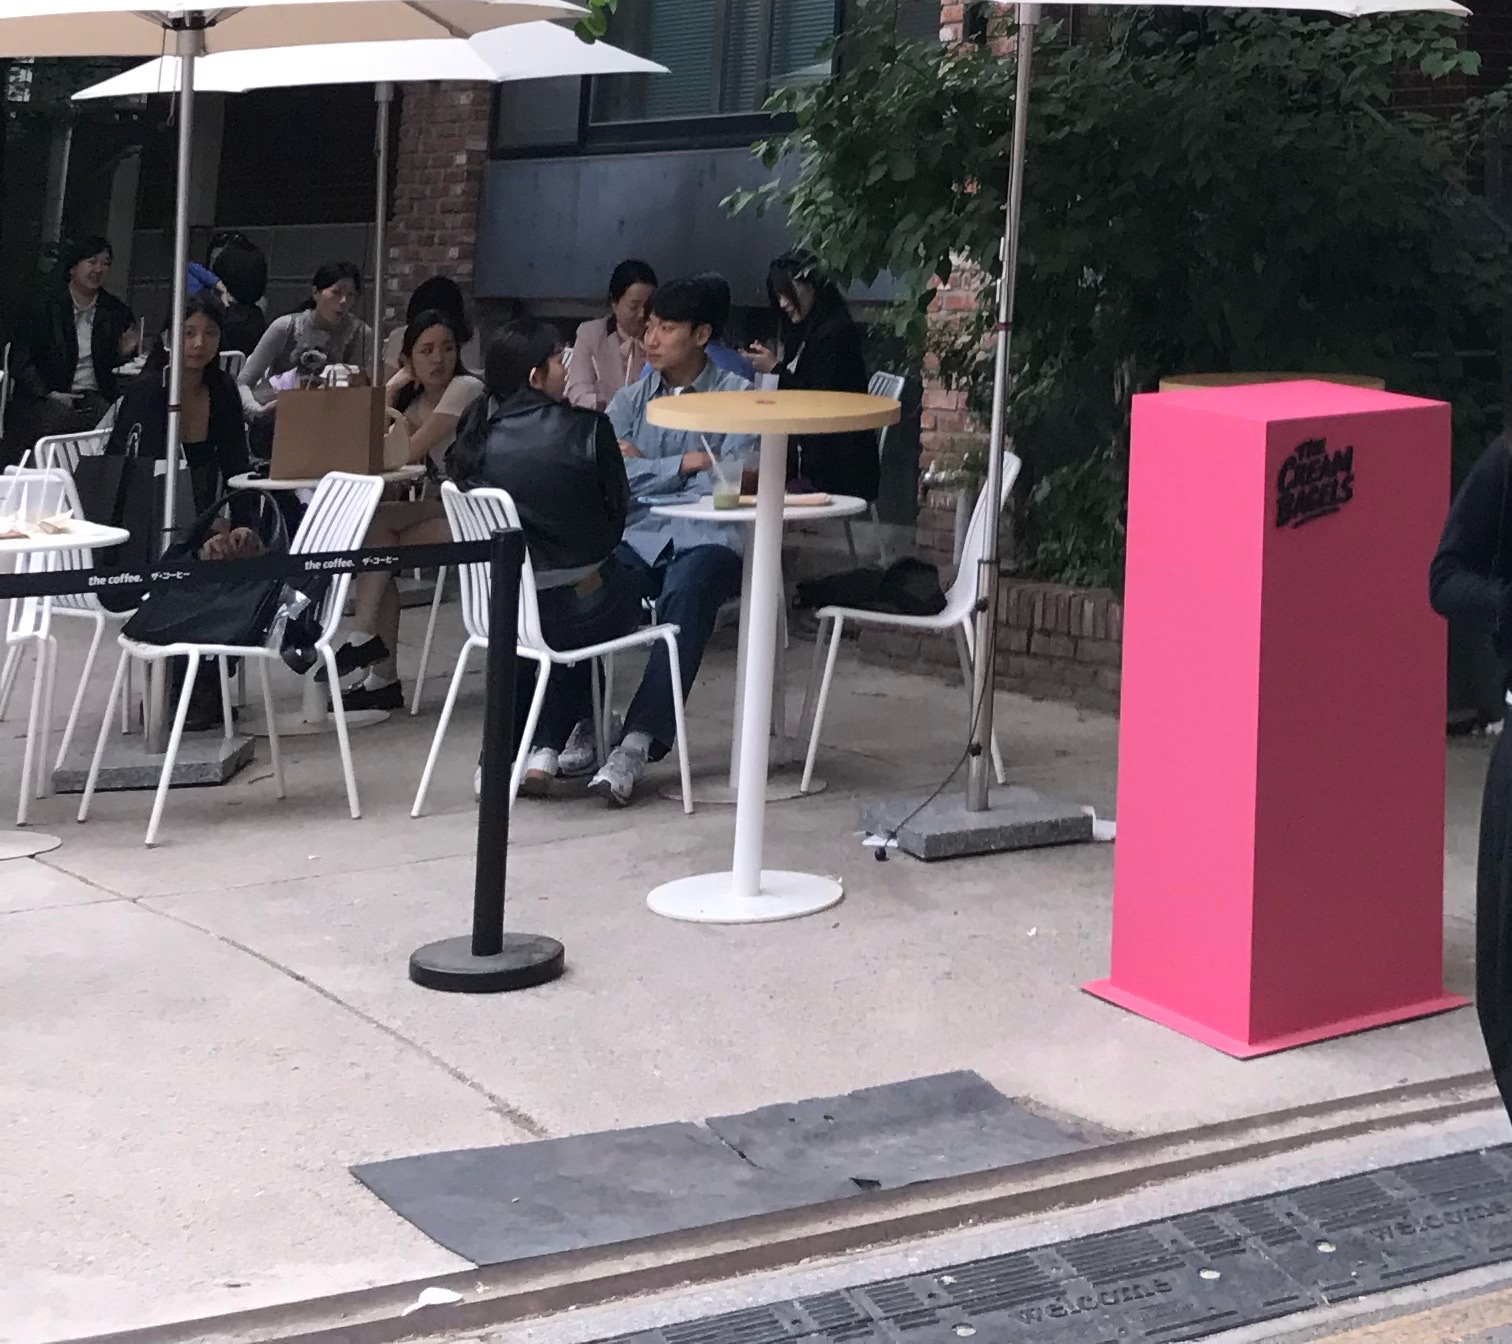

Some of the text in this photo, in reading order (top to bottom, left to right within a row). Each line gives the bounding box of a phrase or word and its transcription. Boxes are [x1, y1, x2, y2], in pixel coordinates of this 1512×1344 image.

[304, 559, 321, 570] the
[323, 557, 355, 569] coffee.
[88, 575, 106, 586] the
[108, 572, 143, 585] coffee.
